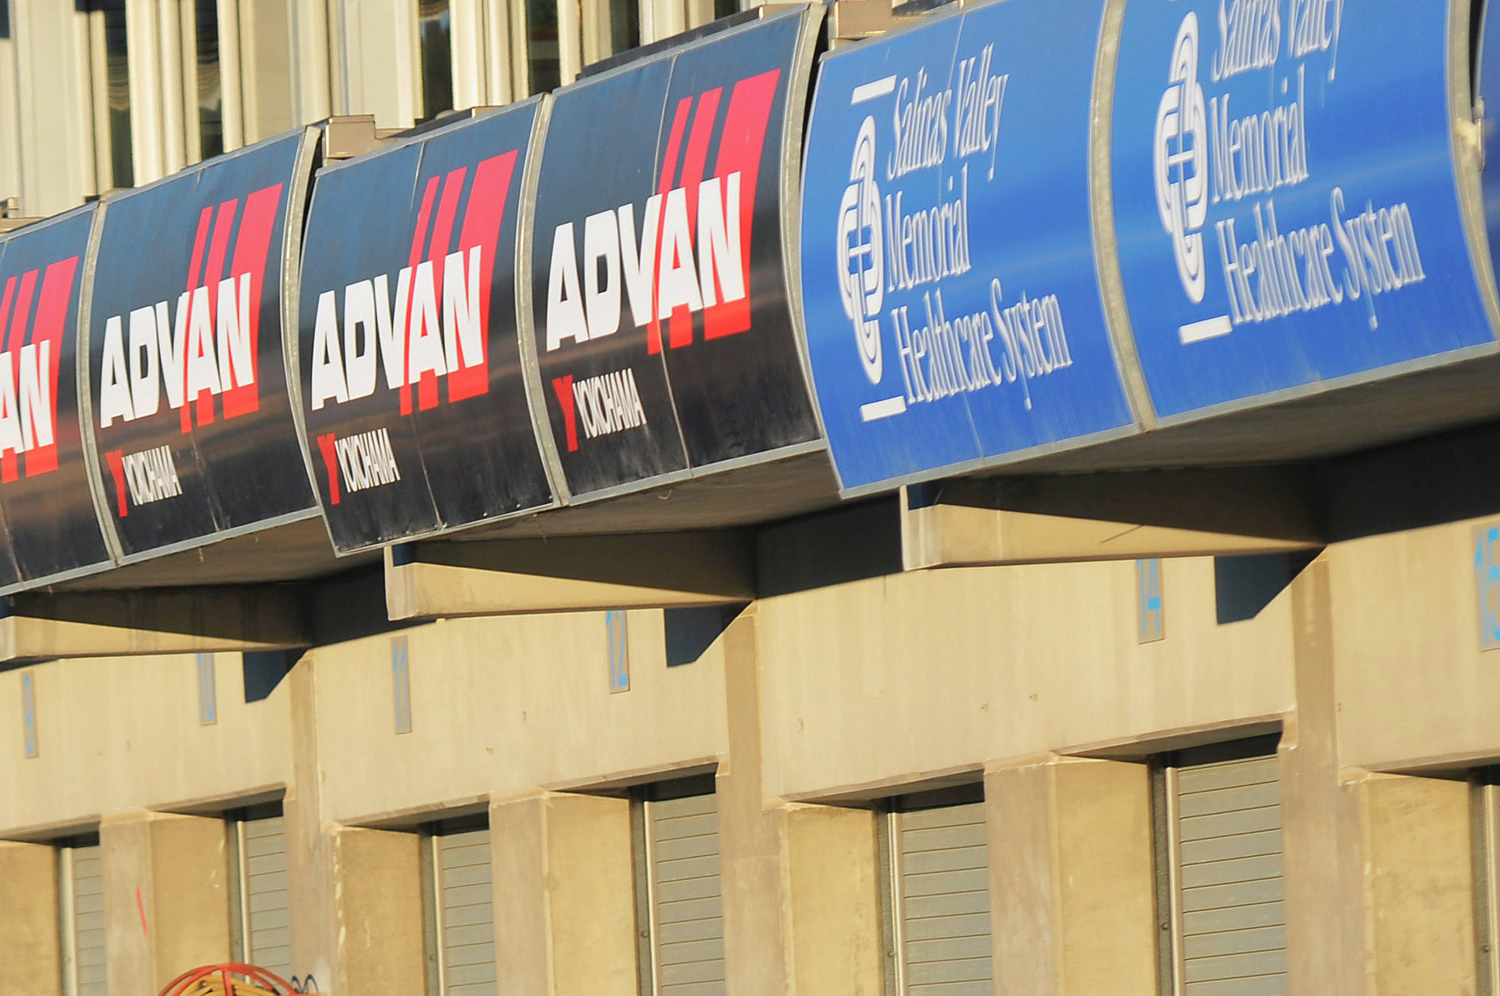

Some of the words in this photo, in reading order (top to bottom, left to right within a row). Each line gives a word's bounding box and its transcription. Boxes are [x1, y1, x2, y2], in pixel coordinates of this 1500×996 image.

[888, 66, 953, 181] Salinas
[954, 42, 1009, 182] Valley
[1210, 62, 1310, 206] Memorial
[546, 171, 746, 352] ADVAN
[885, 162, 972, 293] Memorial
[1215, 199, 1336, 326] Healthcare
[1330, 186, 1427, 330] System
[100, 271, 254, 430] ADVAN
[311, 245, 485, 412] ADVAN
[891, 286, 1003, 405] Healthcare
[989, 277, 1074, 412] System
[334, 428, 401, 494] YOKOHAMA
[571, 368, 647, 440] YOKOHAMA
